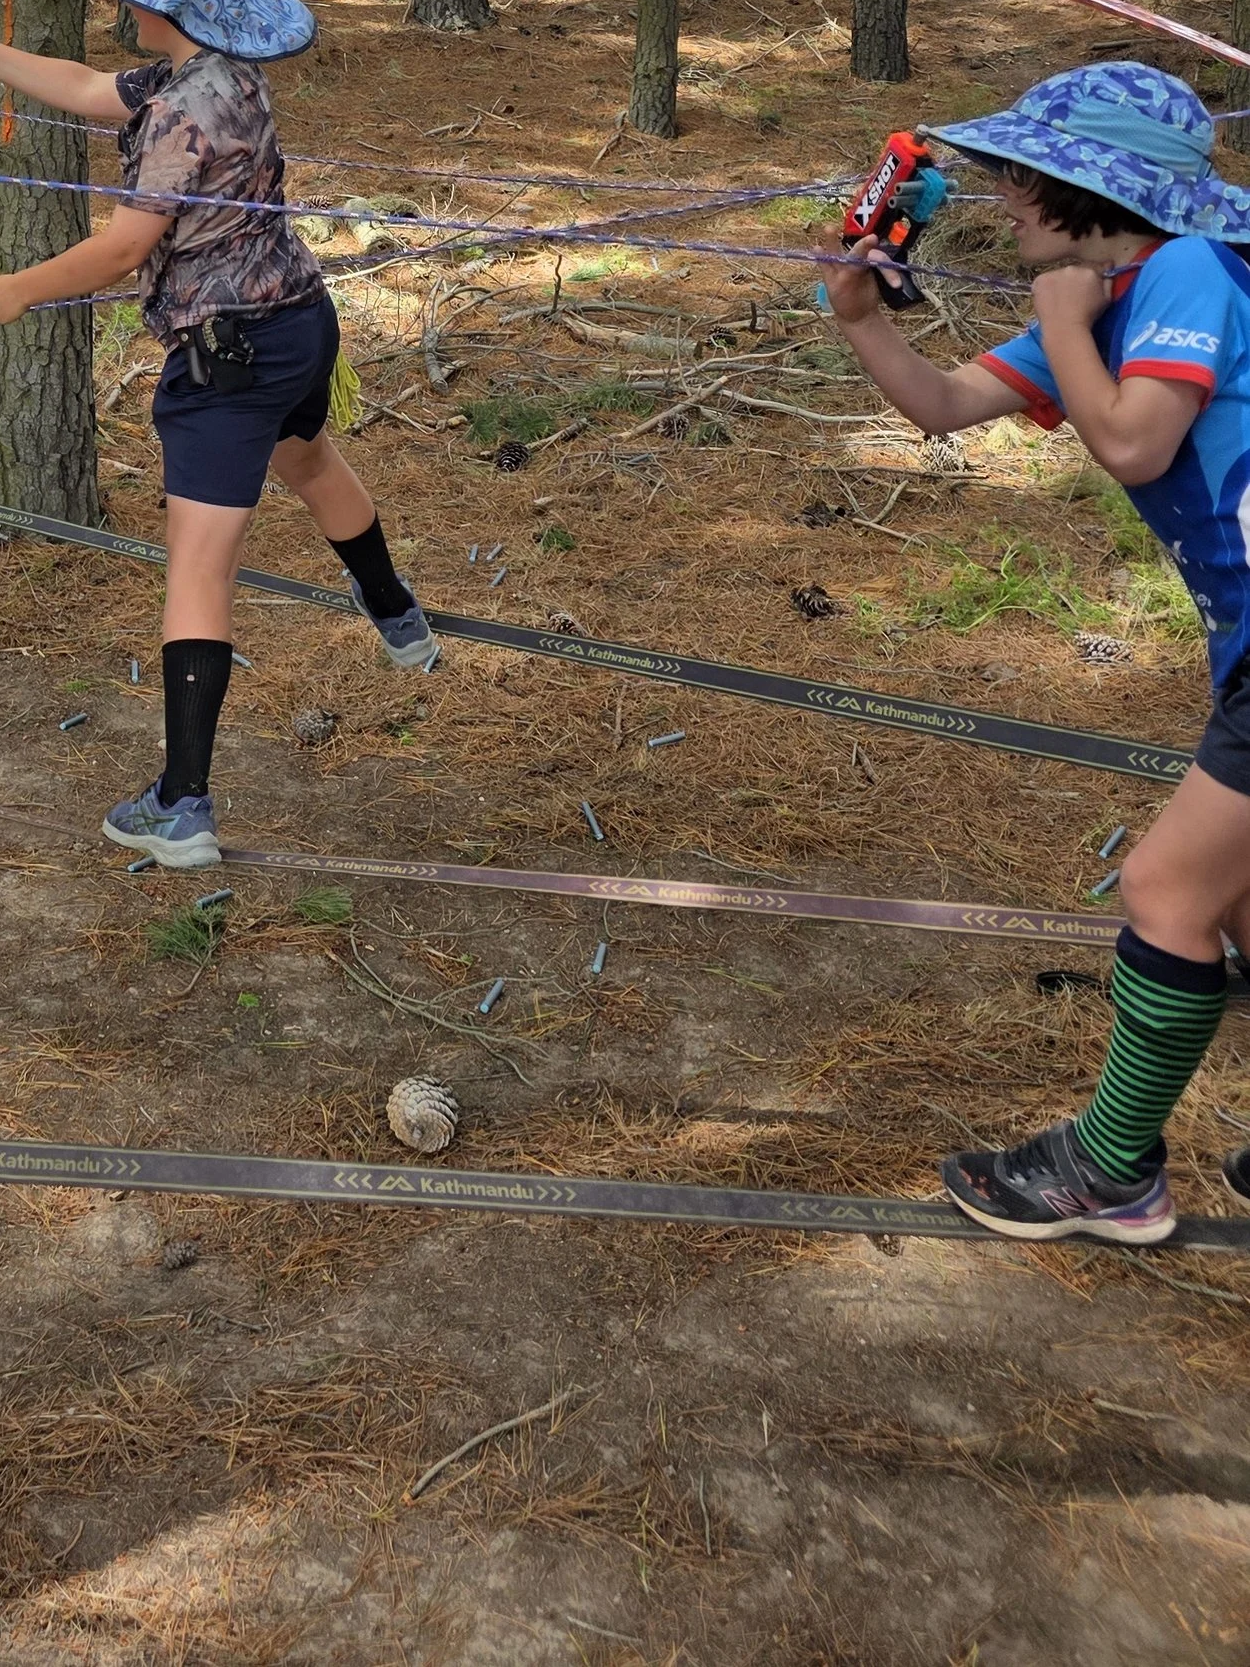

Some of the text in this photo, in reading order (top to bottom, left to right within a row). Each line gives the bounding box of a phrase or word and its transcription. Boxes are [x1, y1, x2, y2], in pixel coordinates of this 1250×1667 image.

[587, 646, 655, 670] Kathmandu
[865, 700, 946, 727] Kathmandu
[324, 859, 407, 874] Kathmandu
[658, 886, 751, 905] Kathmandu
[1042, 919, 1120, 937] Kathma
[420, 1177, 534, 1200] Kathmandu
[872, 1207, 968, 1226] Kathman
